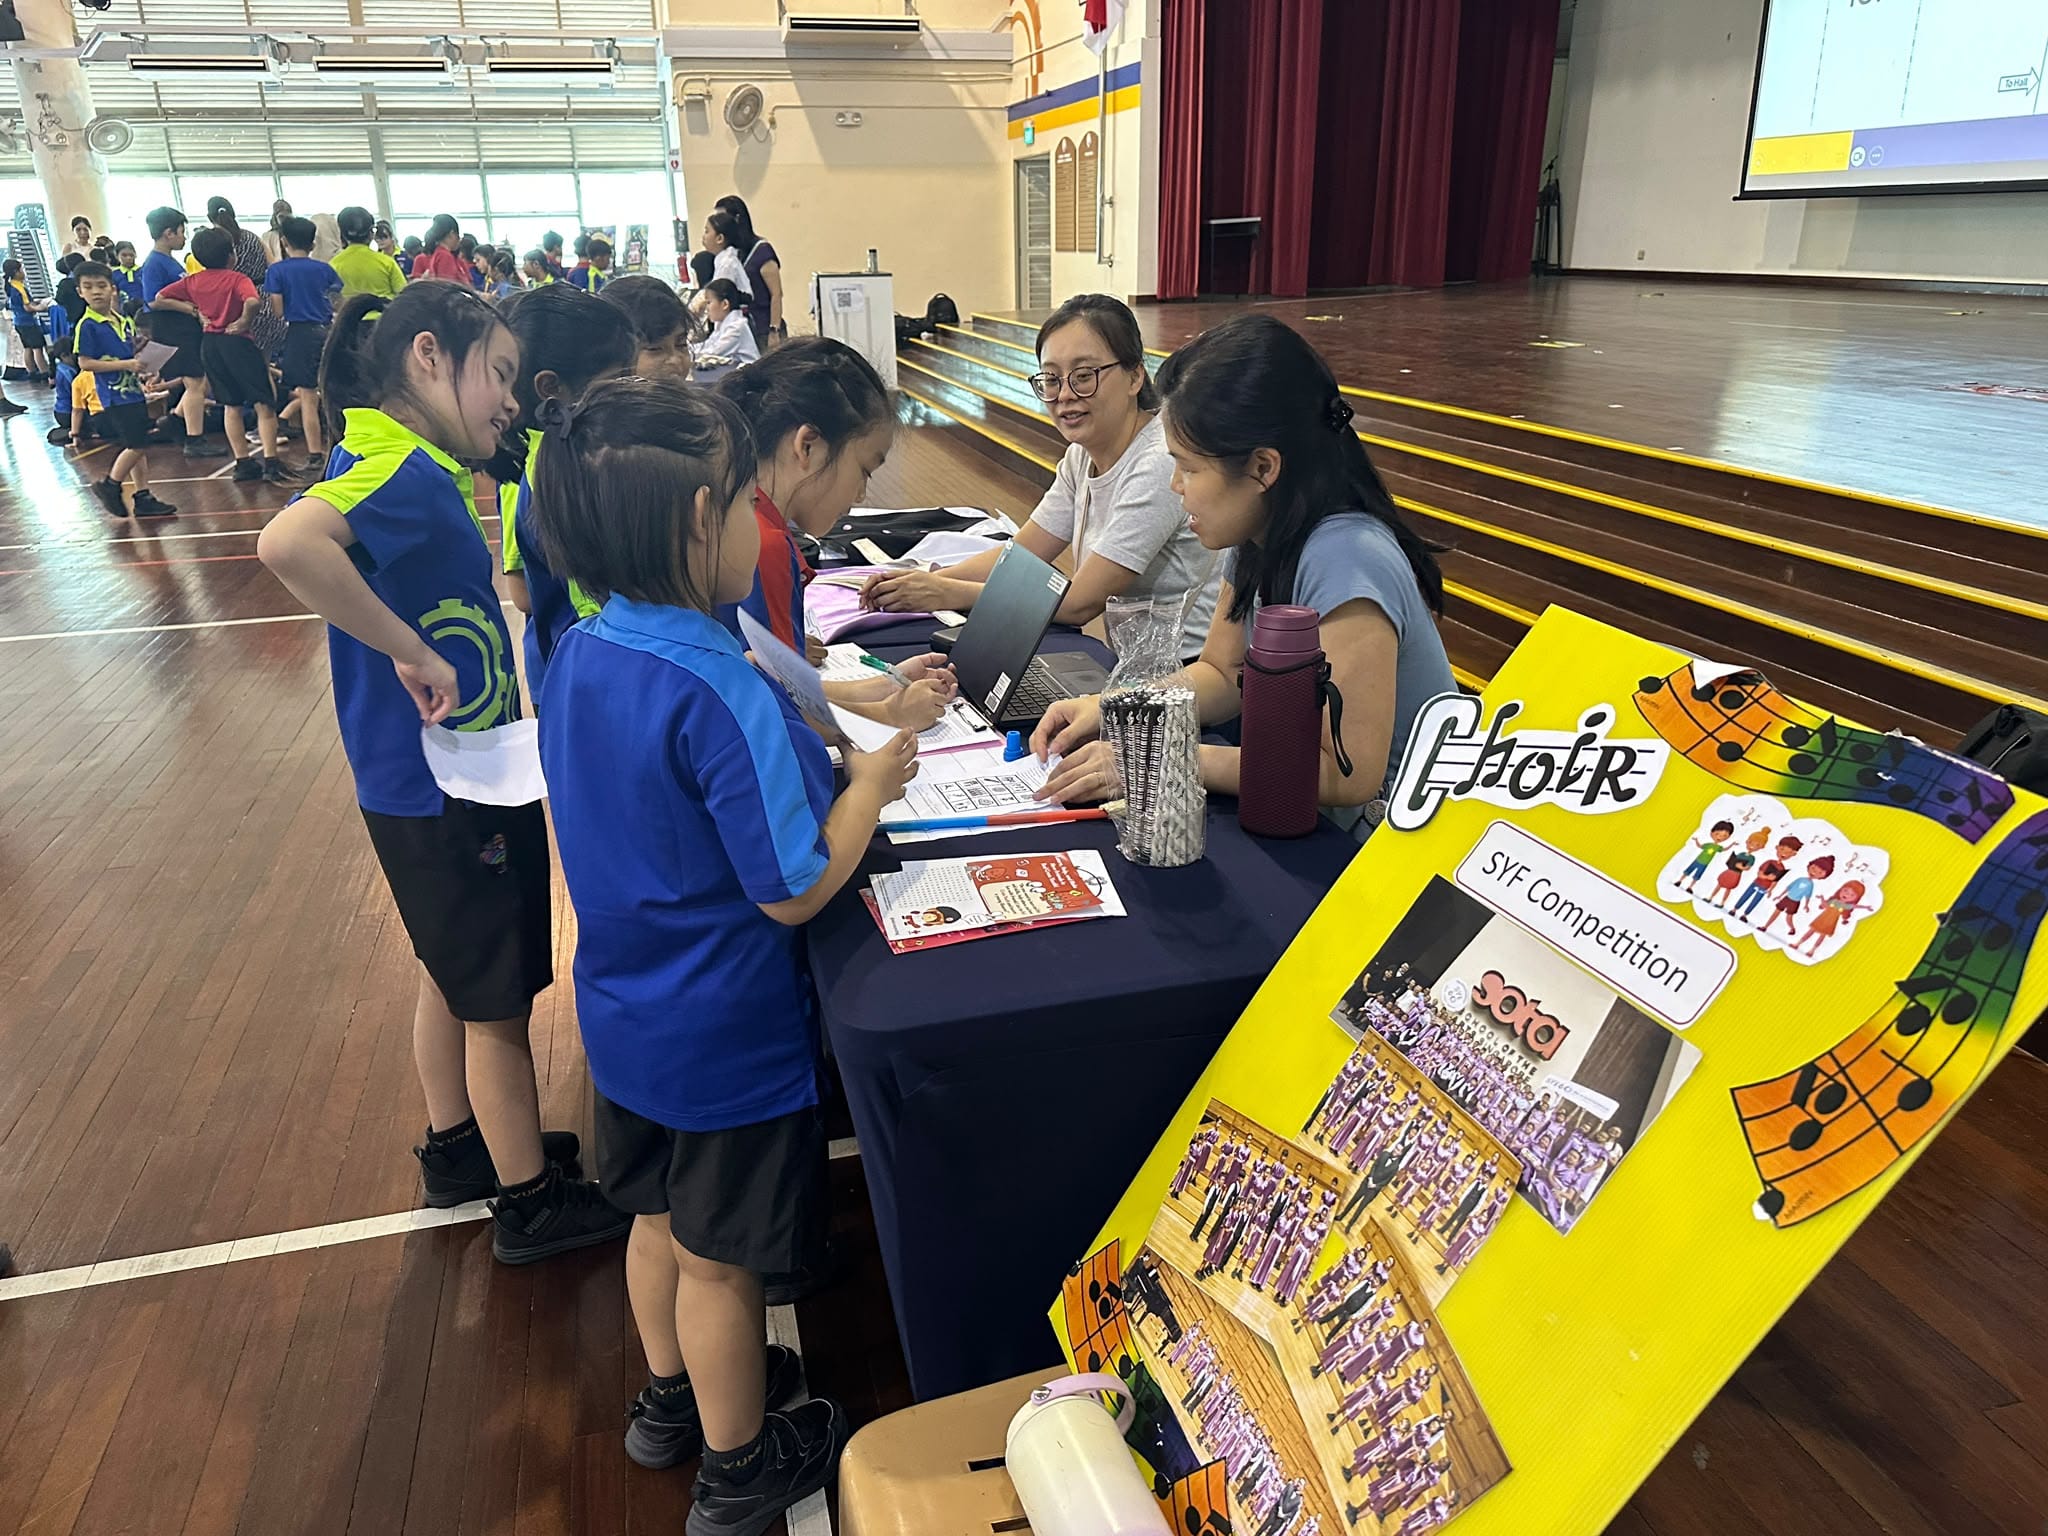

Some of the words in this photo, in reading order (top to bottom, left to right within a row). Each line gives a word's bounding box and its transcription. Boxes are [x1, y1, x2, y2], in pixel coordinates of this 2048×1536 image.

[1482, 850, 1531, 888] SYF
[1526, 880, 1690, 995] Competition
[1517, 1055, 1539, 1076] THE
